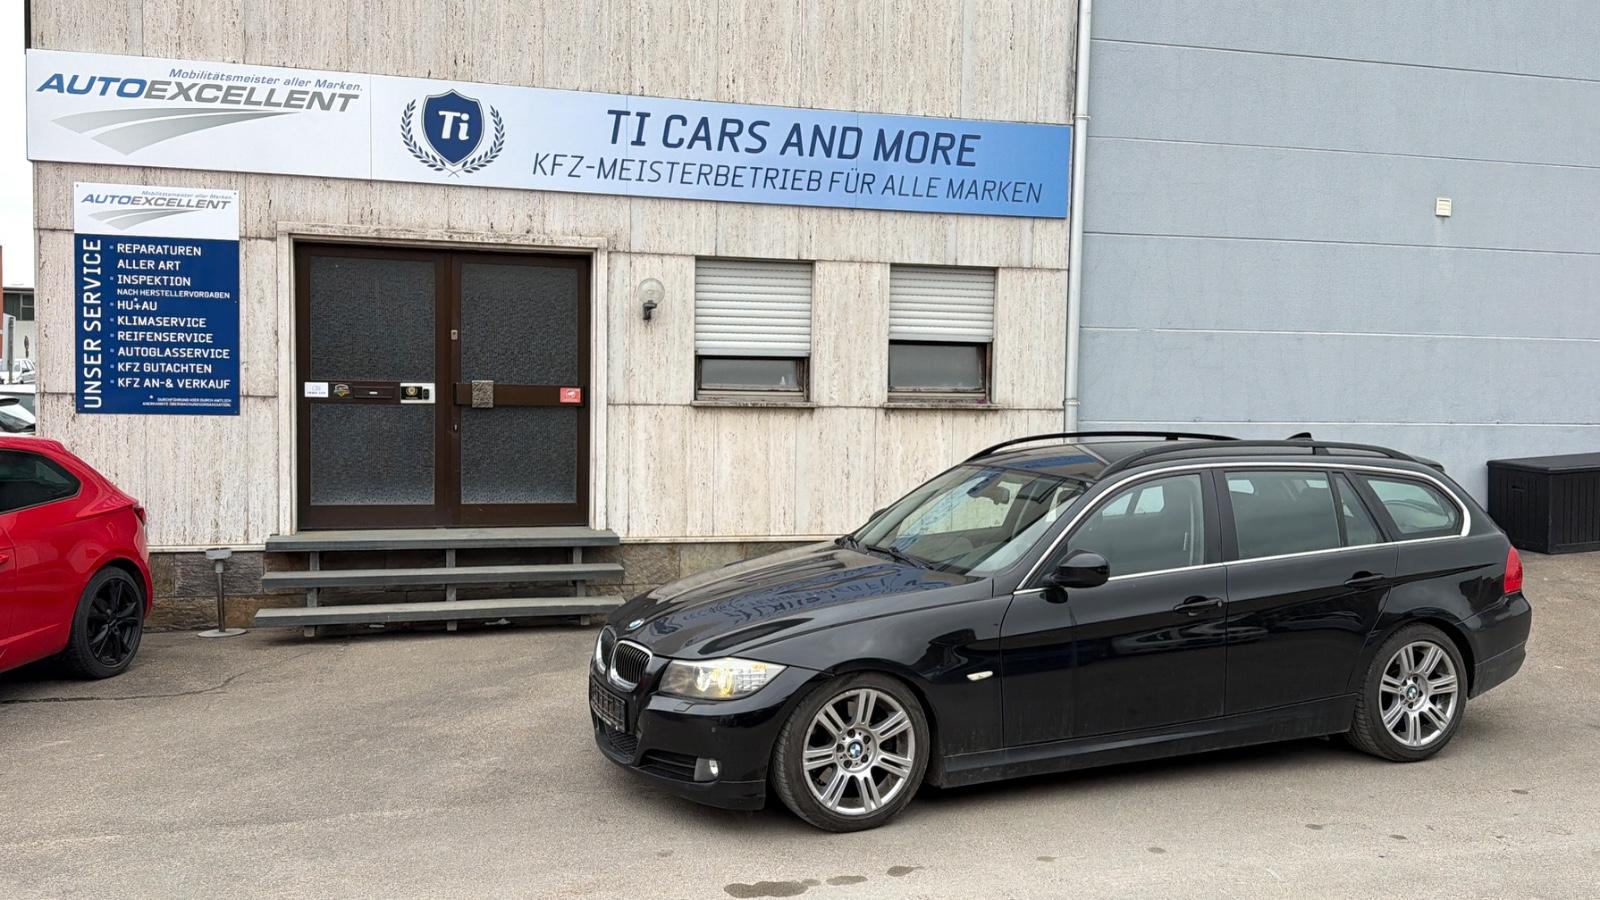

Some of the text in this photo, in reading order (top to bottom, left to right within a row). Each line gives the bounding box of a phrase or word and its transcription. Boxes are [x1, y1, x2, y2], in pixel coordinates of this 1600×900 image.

[169, 68, 363, 92] Mobilitätsmeister aller Marken.
[36, 73, 360, 112] AUTOEXCELLENT
[438, 110, 470, 141] Ti
[607, 109, 982, 167] TI CARS AND MORE
[532, 152, 1043, 204] KFZ-MEISTERBETRIEB FÜR ALLE MARKEN
[81, 193, 231, 210] AUTOEXCELLENT
[117, 243, 201, 256] REPARATUREN
[117, 259, 181, 271] ALLER ART
[117, 275, 191, 287] INSPEKTION
[117, 288, 230, 299] NACH HERSTELLERVORGABEN
[83, 239, 102, 409] UNSER SERVICE
[117, 316, 206, 328] KLIMASERVICE
[117, 331, 213, 343] REIFENSERVICE
[118, 347, 230, 359] AUTOGLASSERVICE
[118, 362, 212, 374] KFZ GUTACHTEN
[118, 378, 140, 388] KFZ
[177, 379, 231, 389] VERKAUF
